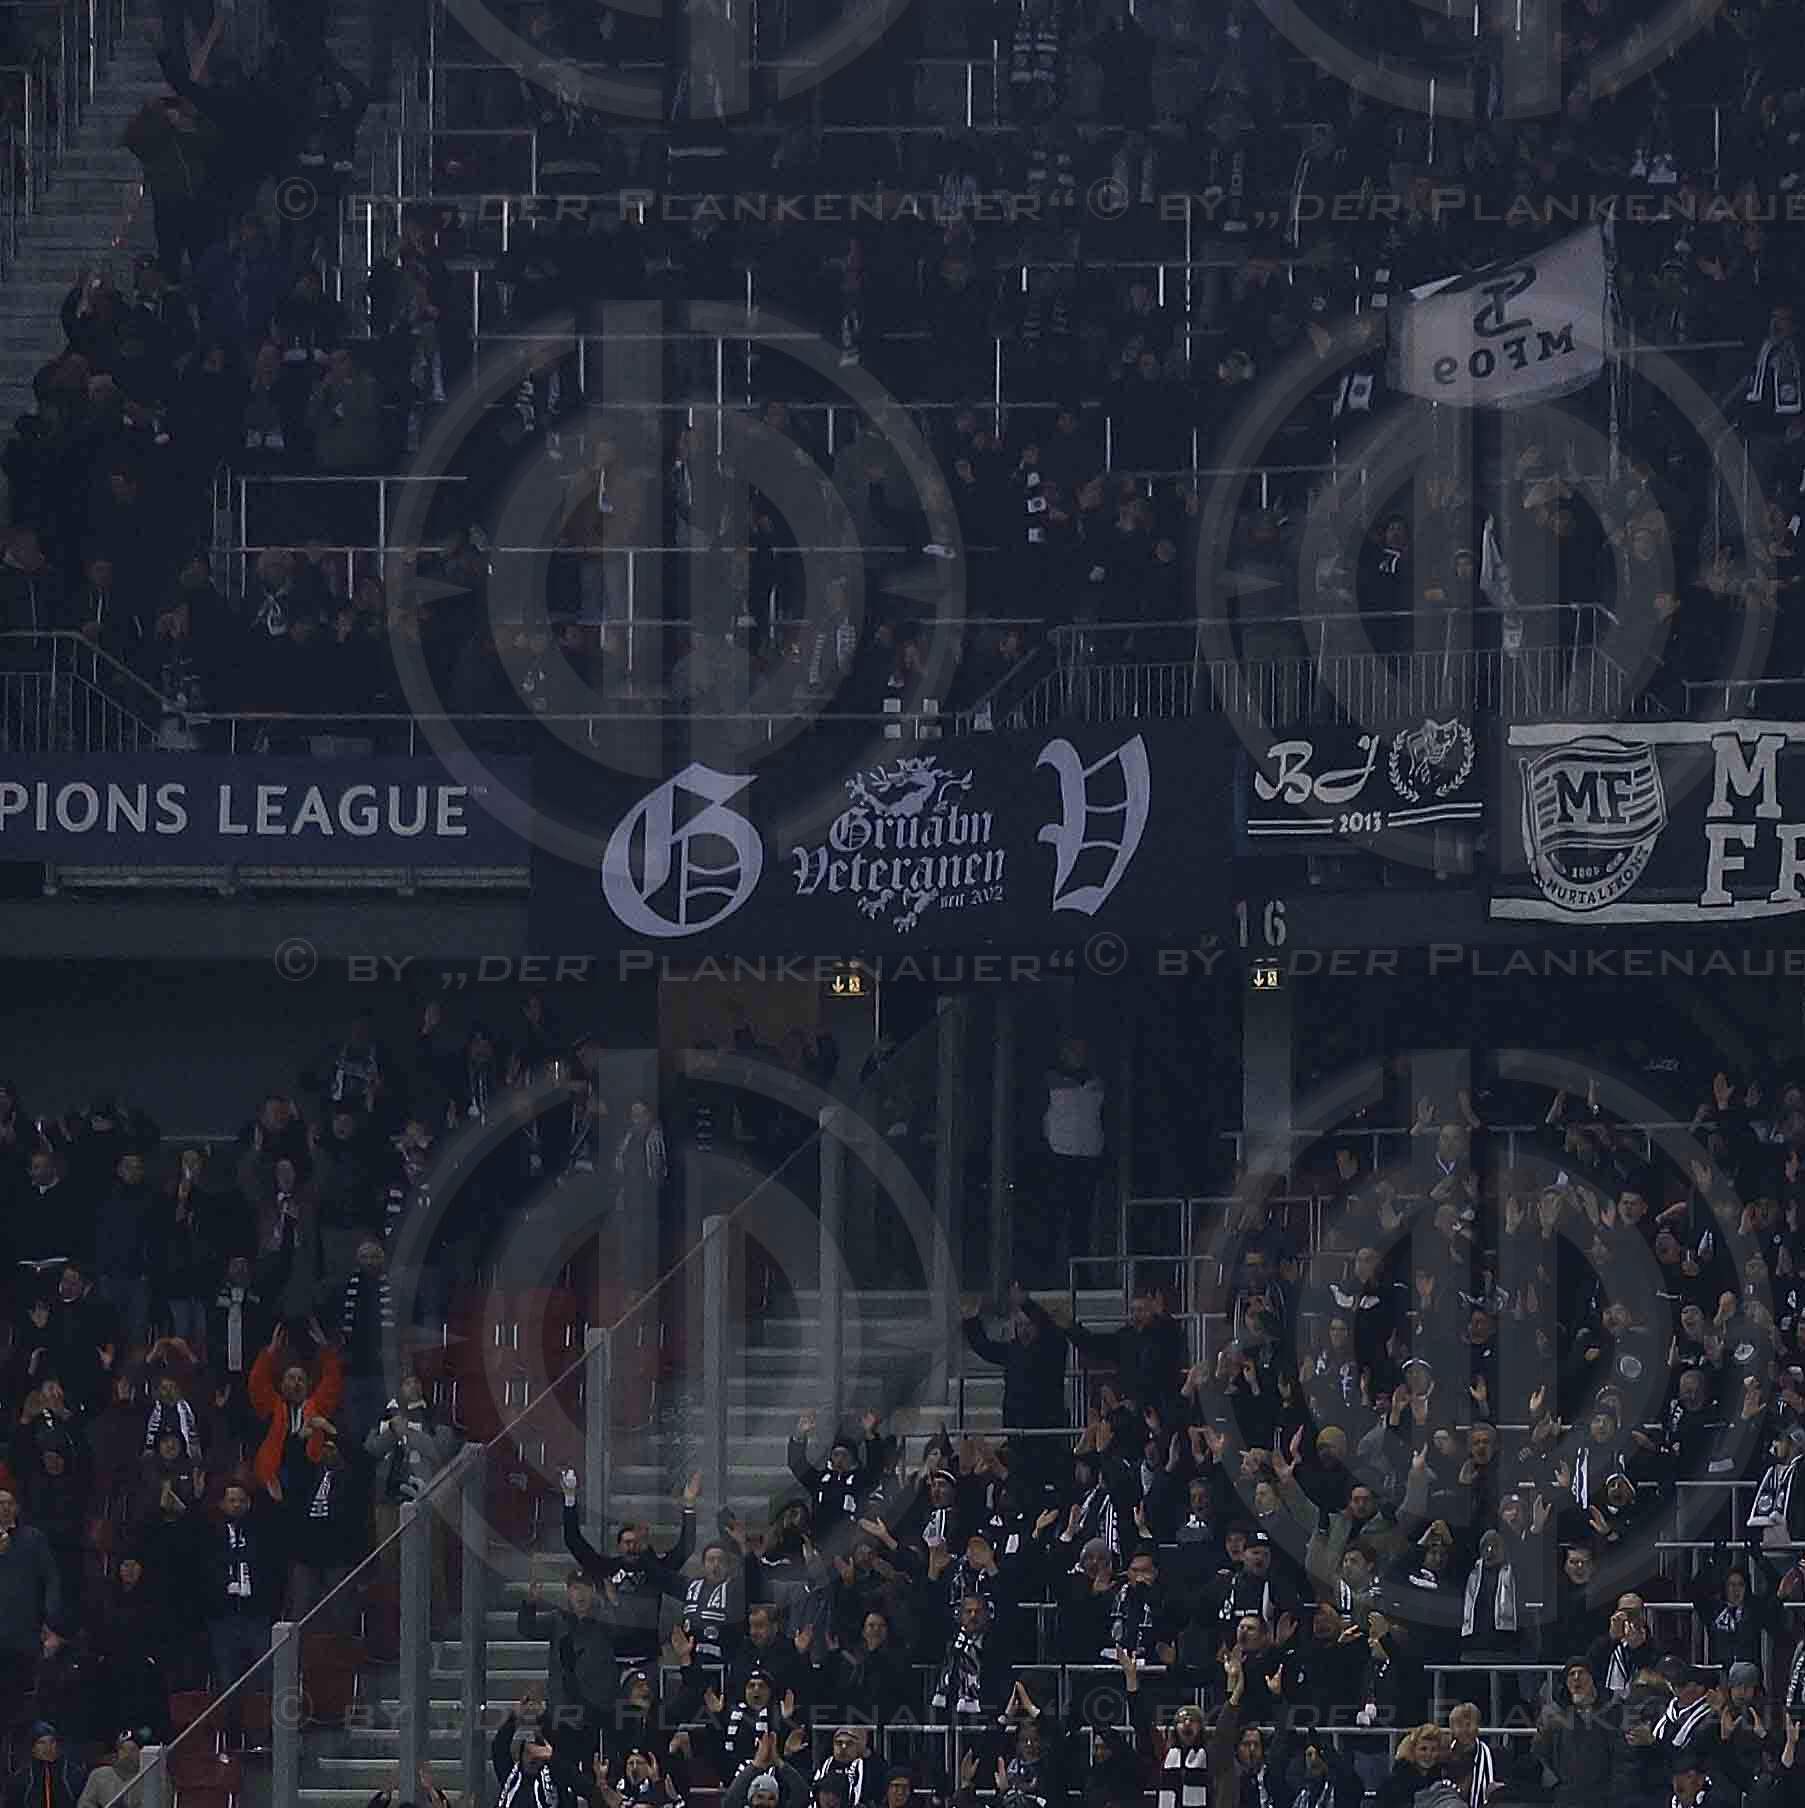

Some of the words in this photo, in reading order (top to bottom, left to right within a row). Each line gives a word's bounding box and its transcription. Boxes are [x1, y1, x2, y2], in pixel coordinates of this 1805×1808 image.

[217, 783, 469, 837] LEAGUE
[1338, 811, 1384, 833] 2013
[1552, 767, 1634, 825] MF
[791, 844, 1006, 896] Veteranen
